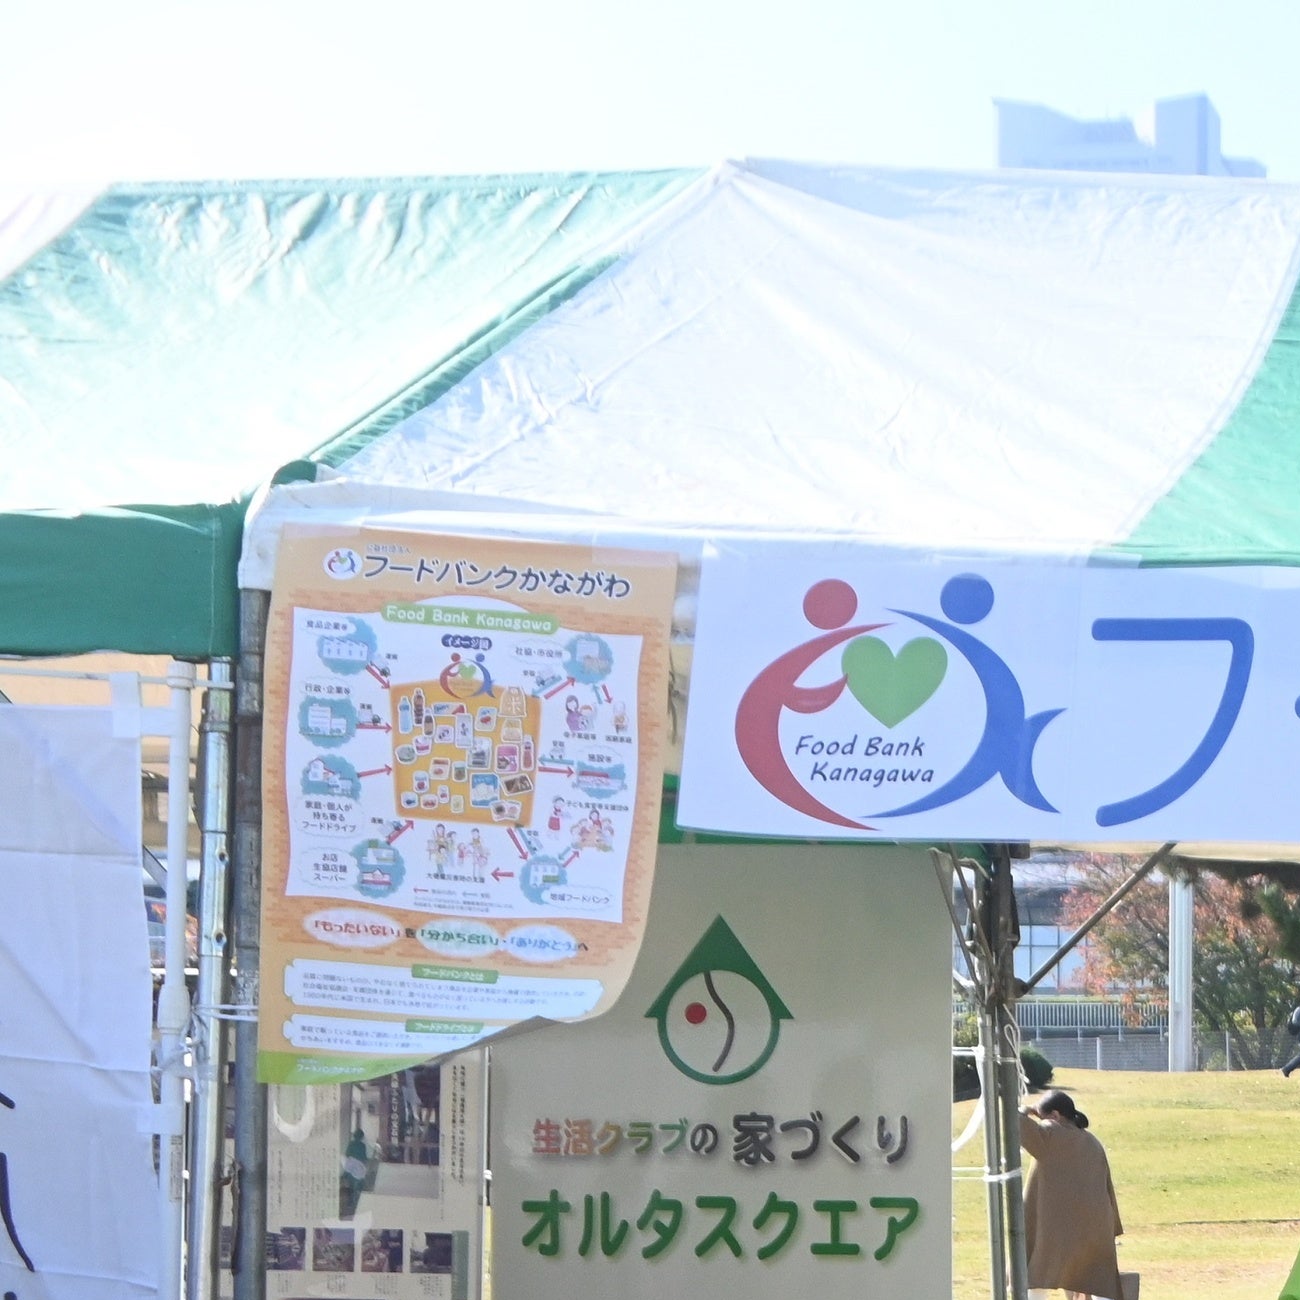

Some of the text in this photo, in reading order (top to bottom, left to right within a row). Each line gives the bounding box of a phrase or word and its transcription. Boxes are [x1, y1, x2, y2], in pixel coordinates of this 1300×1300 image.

[365, 555, 631, 598] フードバンクかながわ
[386, 605, 552, 631] Food Bank Kanagawa
[795, 734, 925, 756] Food Bank
[810, 761, 935, 788] Kanagawa
[302, 821, 356, 833] フードドライブ
[531, 1111, 910, 1166] 生活クラブの家づくり
[521, 1189, 920, 1261] オルタスクエア
